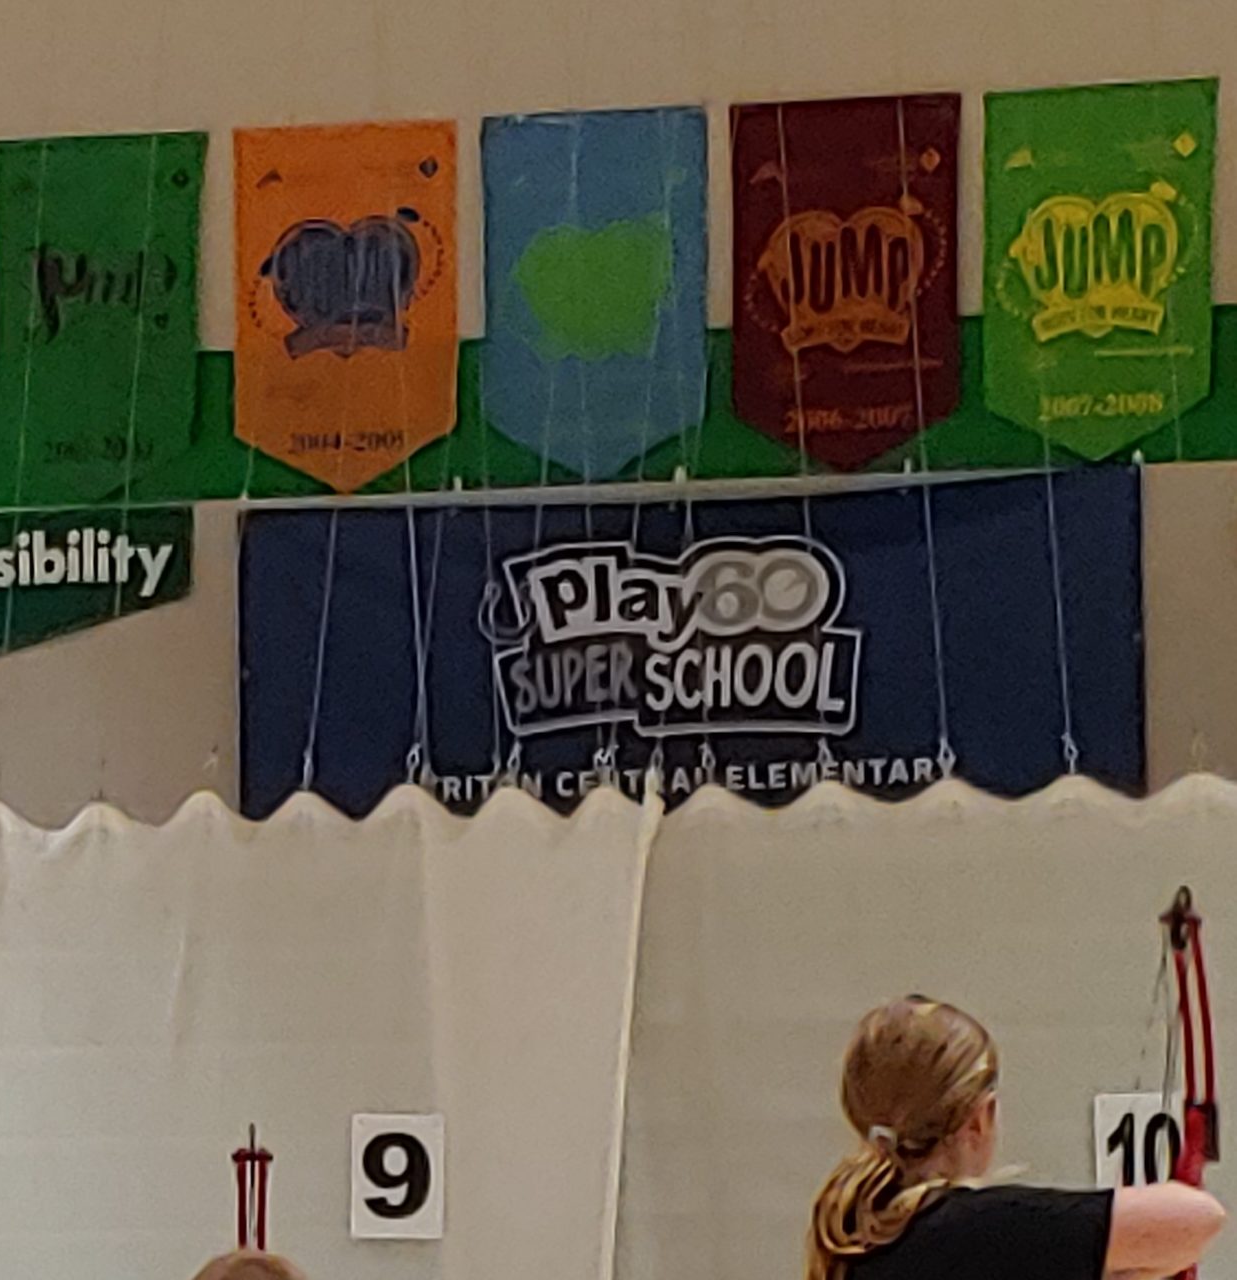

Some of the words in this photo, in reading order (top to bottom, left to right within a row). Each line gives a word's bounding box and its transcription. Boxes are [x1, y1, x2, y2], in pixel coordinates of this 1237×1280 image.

[1034, 208, 1168, 300] JUMP
[509, 642, 638, 714] SUPER
[644, 641, 846, 712] SCHOOL
[363, 1132, 431, 1219] 9
[1107, 1112, 1181, 1187] 10
